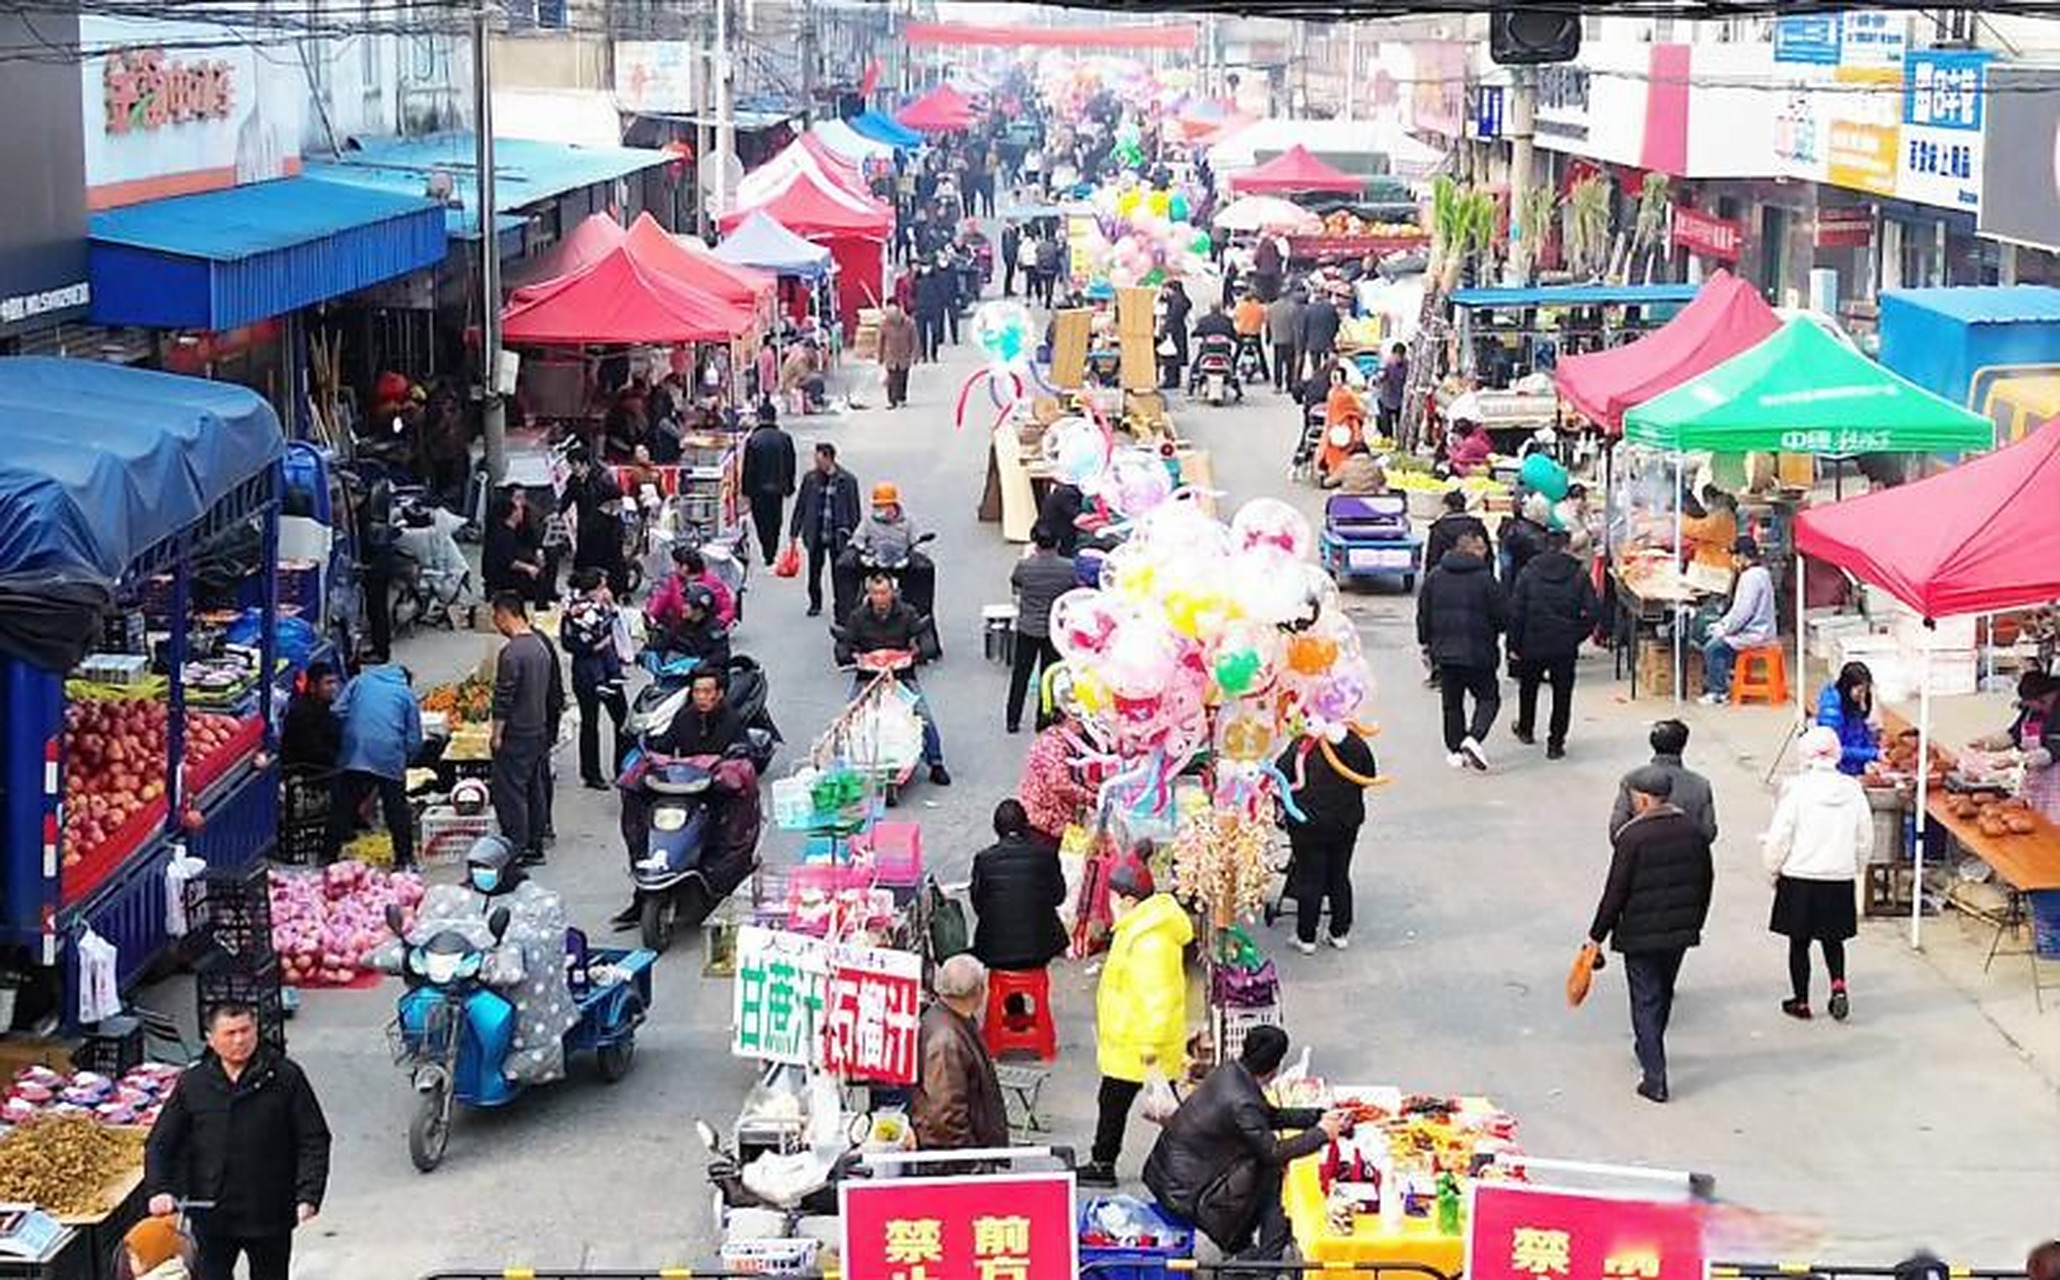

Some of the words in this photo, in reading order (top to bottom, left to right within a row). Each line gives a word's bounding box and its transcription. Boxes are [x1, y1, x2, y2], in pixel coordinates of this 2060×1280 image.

[740, 955, 824, 1057] 甘蔗汁
[826, 978, 916, 1076] 石榴汁
[1512, 1228, 1571, 1280] 禁
